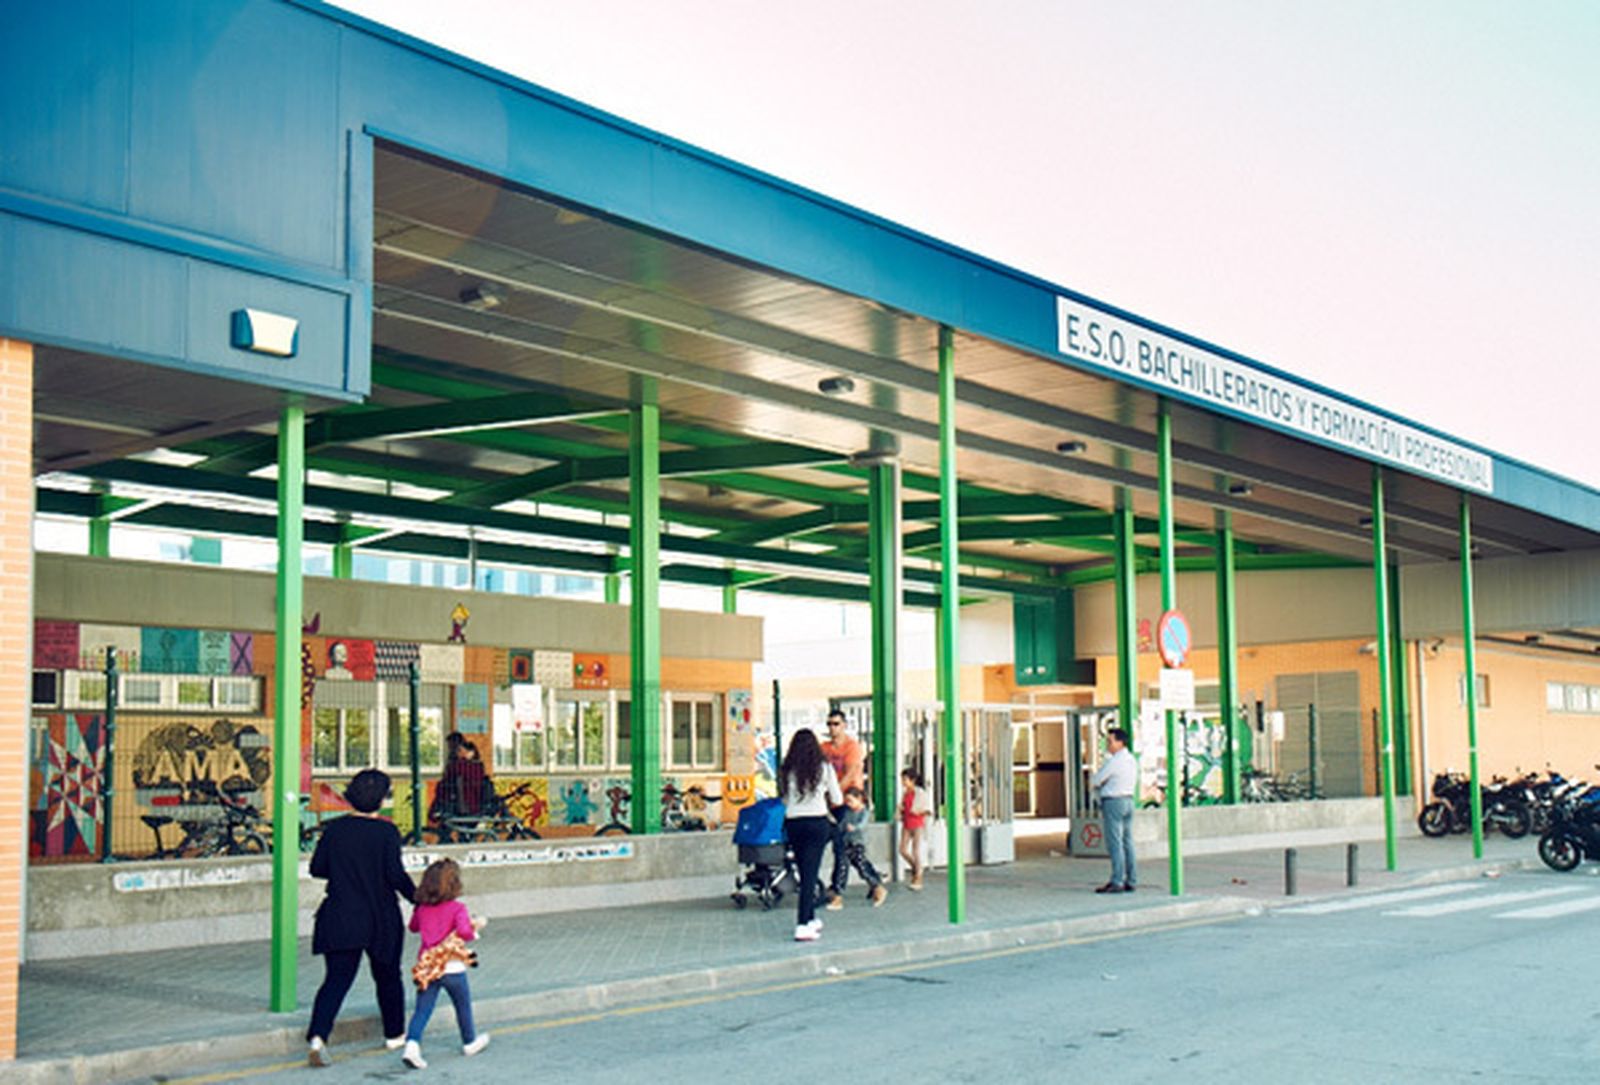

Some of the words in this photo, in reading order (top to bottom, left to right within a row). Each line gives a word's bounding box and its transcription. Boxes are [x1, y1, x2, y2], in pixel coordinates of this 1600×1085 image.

[1066, 314, 1132, 368] E.S.O.
[1138, 340, 1292, 422] BACHILLERATOS
[1296, 397, 1308, 427] Y
[1311, 403, 1402, 458] FORMACIÓN
[1405, 436, 1490, 488] PROFESIONAL
